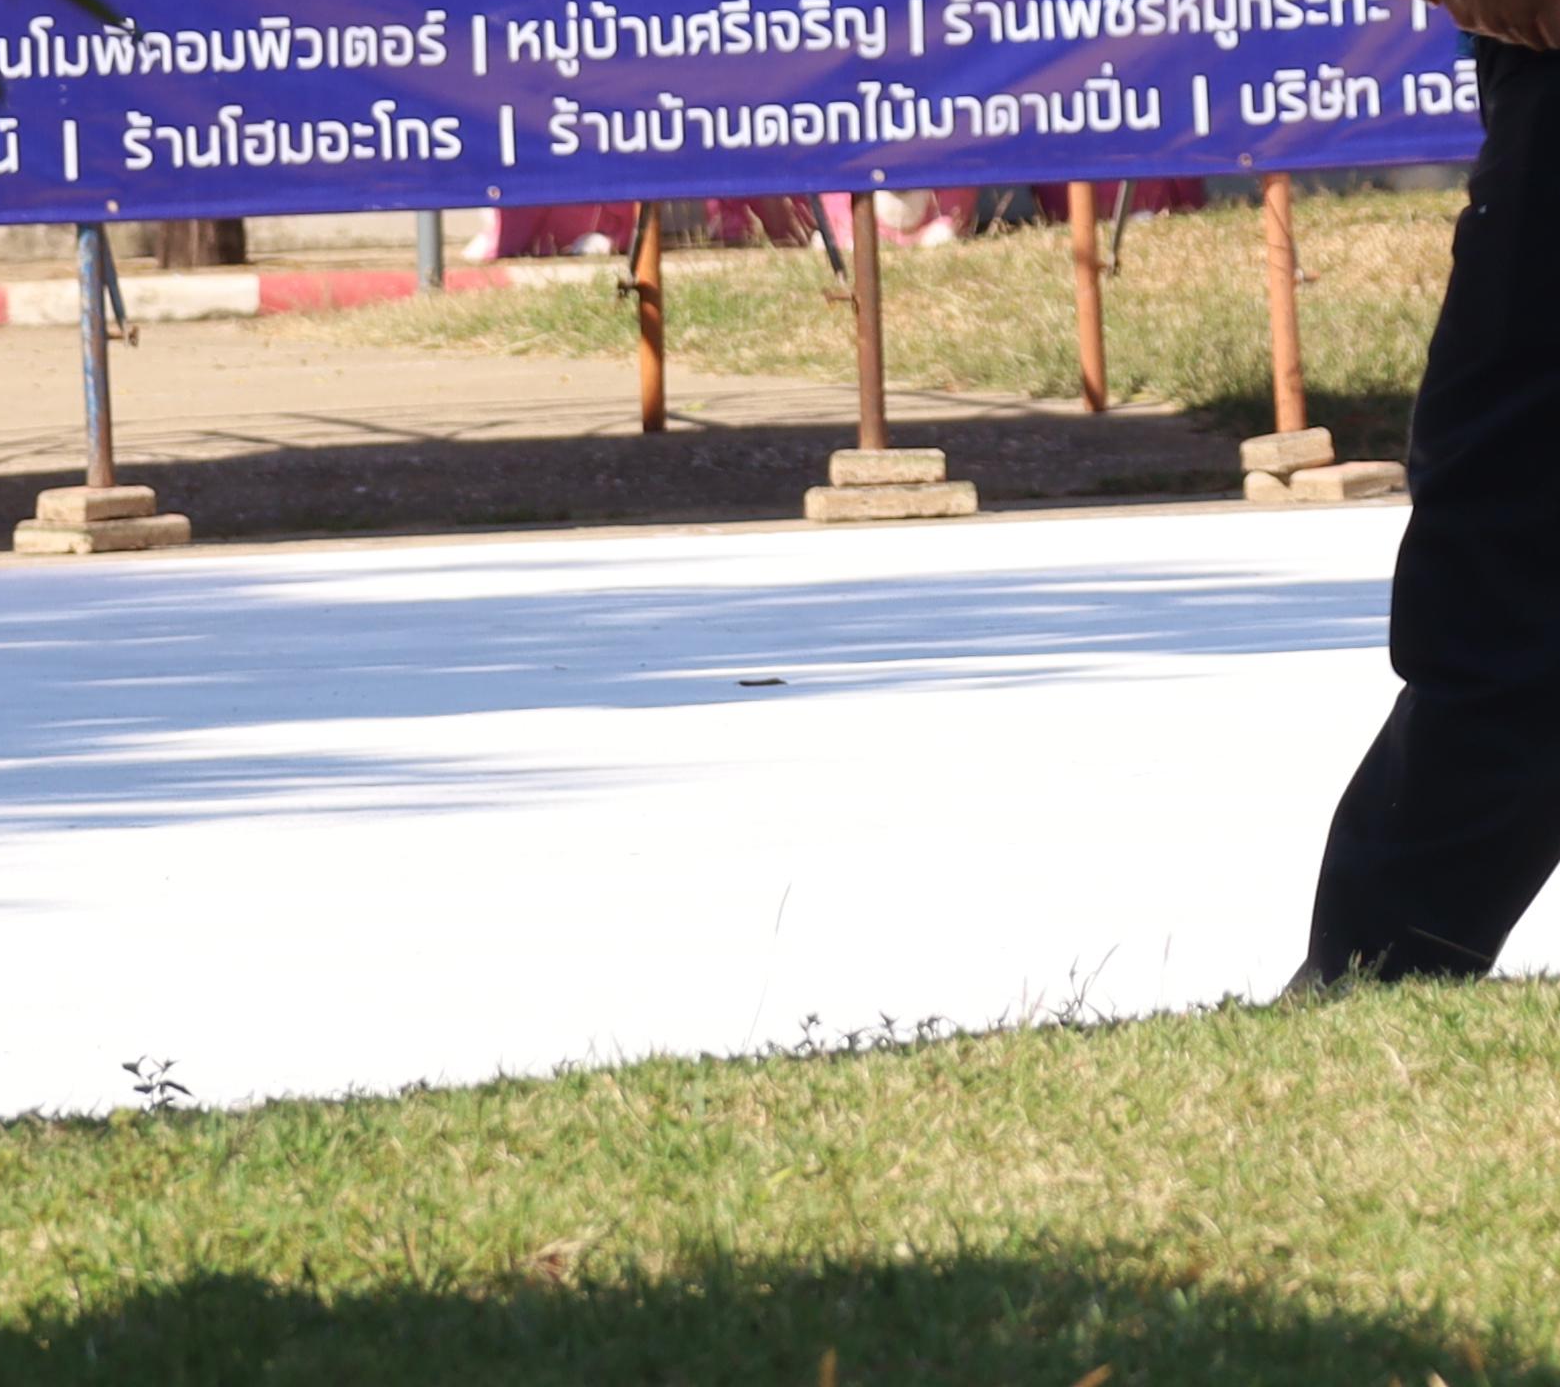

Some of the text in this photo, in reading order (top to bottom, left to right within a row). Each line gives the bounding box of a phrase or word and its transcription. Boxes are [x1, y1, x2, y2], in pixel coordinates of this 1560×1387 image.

[124, 99, 462, 171] ร้านโฮมอะโกร
[548, 64, 1160, 157] ร้านบ้านดอกไม้มาดามปิ่น
[1241, 63, 1381, 128] บริษัท
